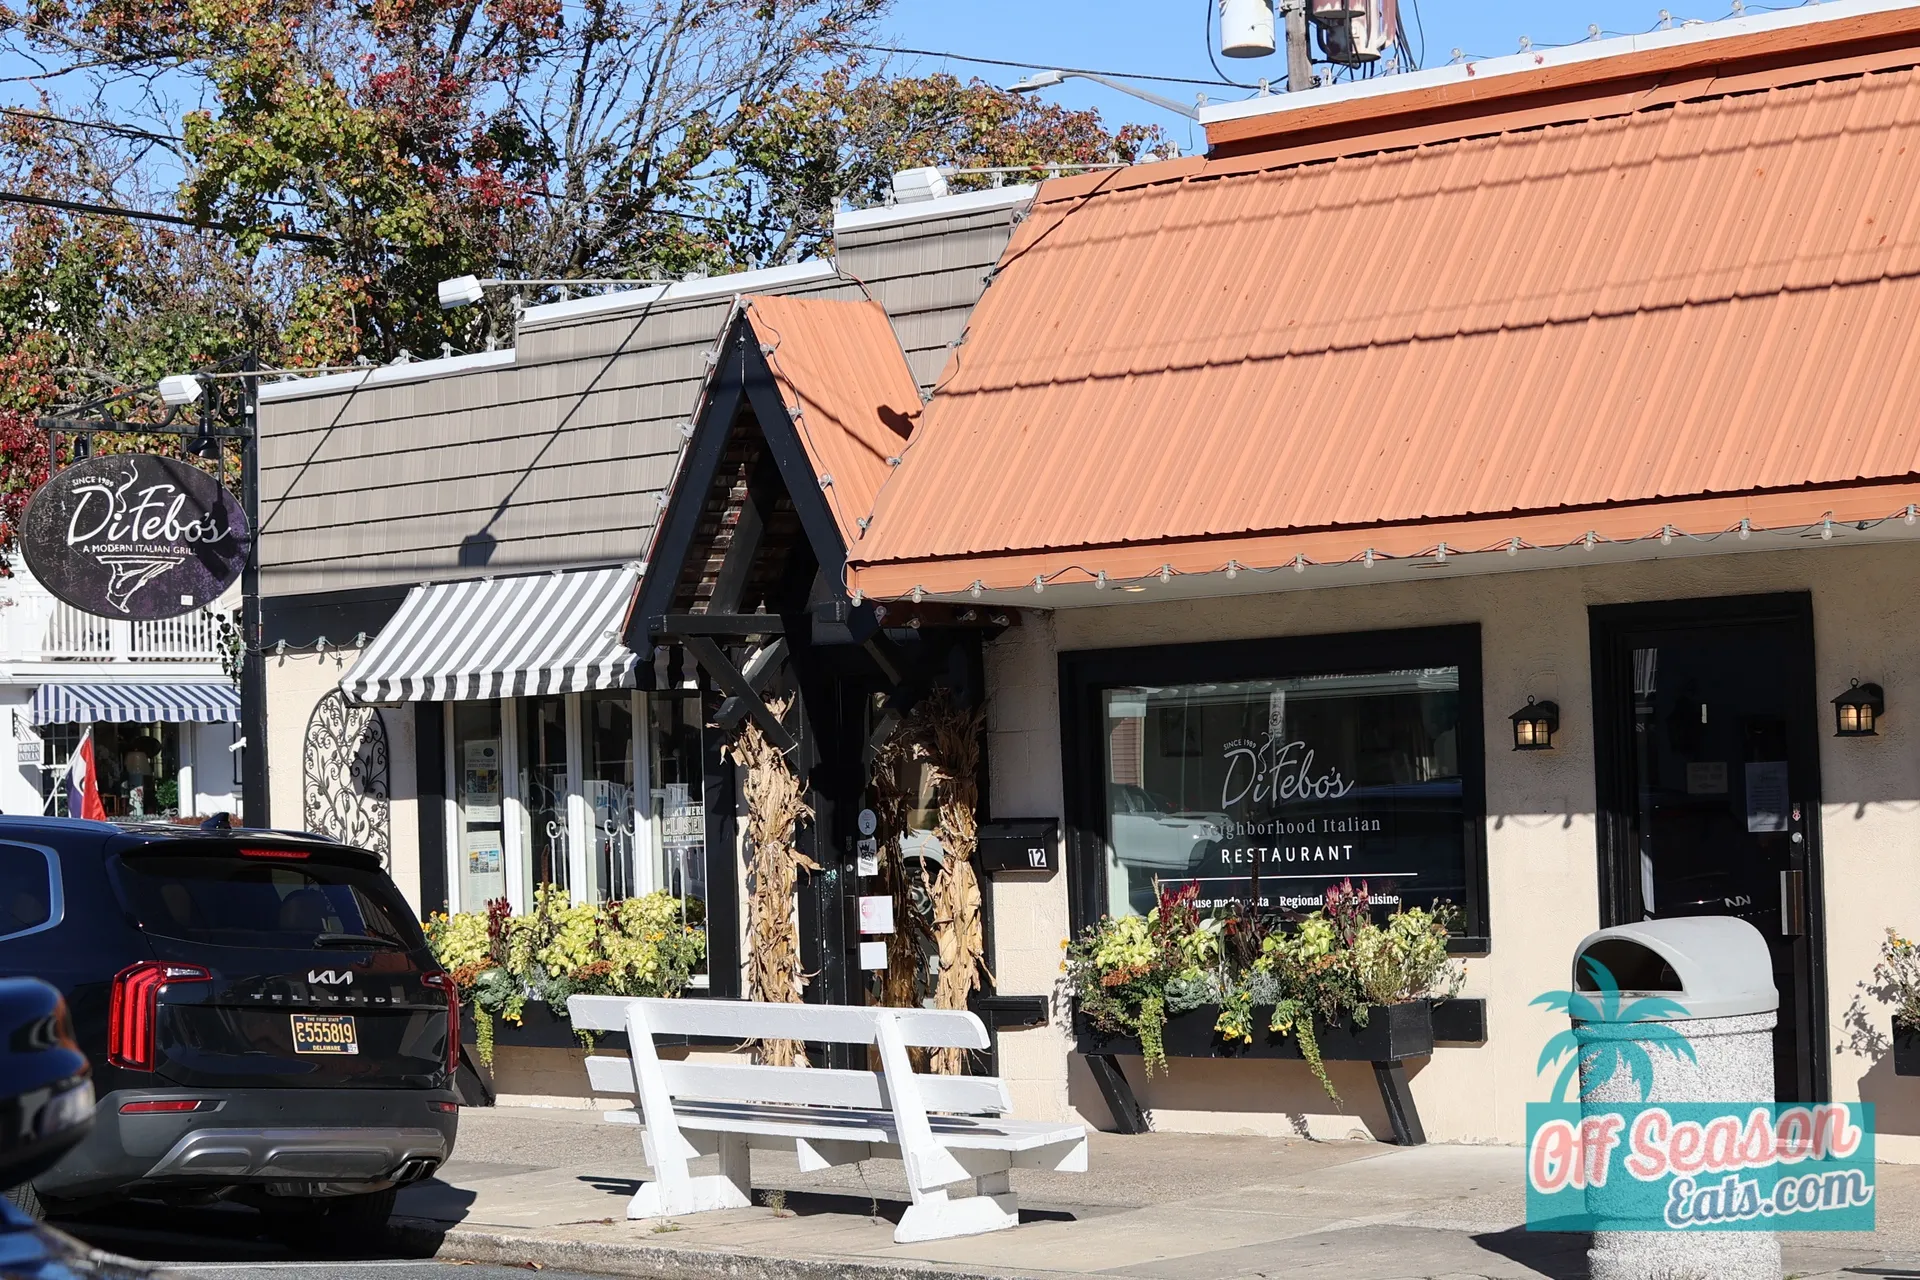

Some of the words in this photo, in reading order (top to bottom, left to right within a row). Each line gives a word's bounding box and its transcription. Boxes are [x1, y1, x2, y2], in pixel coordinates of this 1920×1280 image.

[71, 476, 96, 487] SINCE
[67, 484, 232, 546] DiFebo's
[82, 545, 90, 553] A
[92, 544, 133, 553] MODERN
[135, 544, 171, 554] ITALIAN
[1223, 738, 1242, 751] SINCE
[1243, 738, 1257, 749] 1989
[1221, 740, 1355, 810] DiFebo's
[1200, 817, 1317, 840] Neighborhood
[1322, 816, 1382, 834] Italian
[1029, 849, 1045, 866] 12
[1221, 844, 1353, 864] RESTAURANT
[1280, 894, 1323, 909] Regional
[1367, 893, 1399, 905] uisine
[307, 969, 354, 985] KIA
[250, 993, 401, 1004] TELLURIDE
